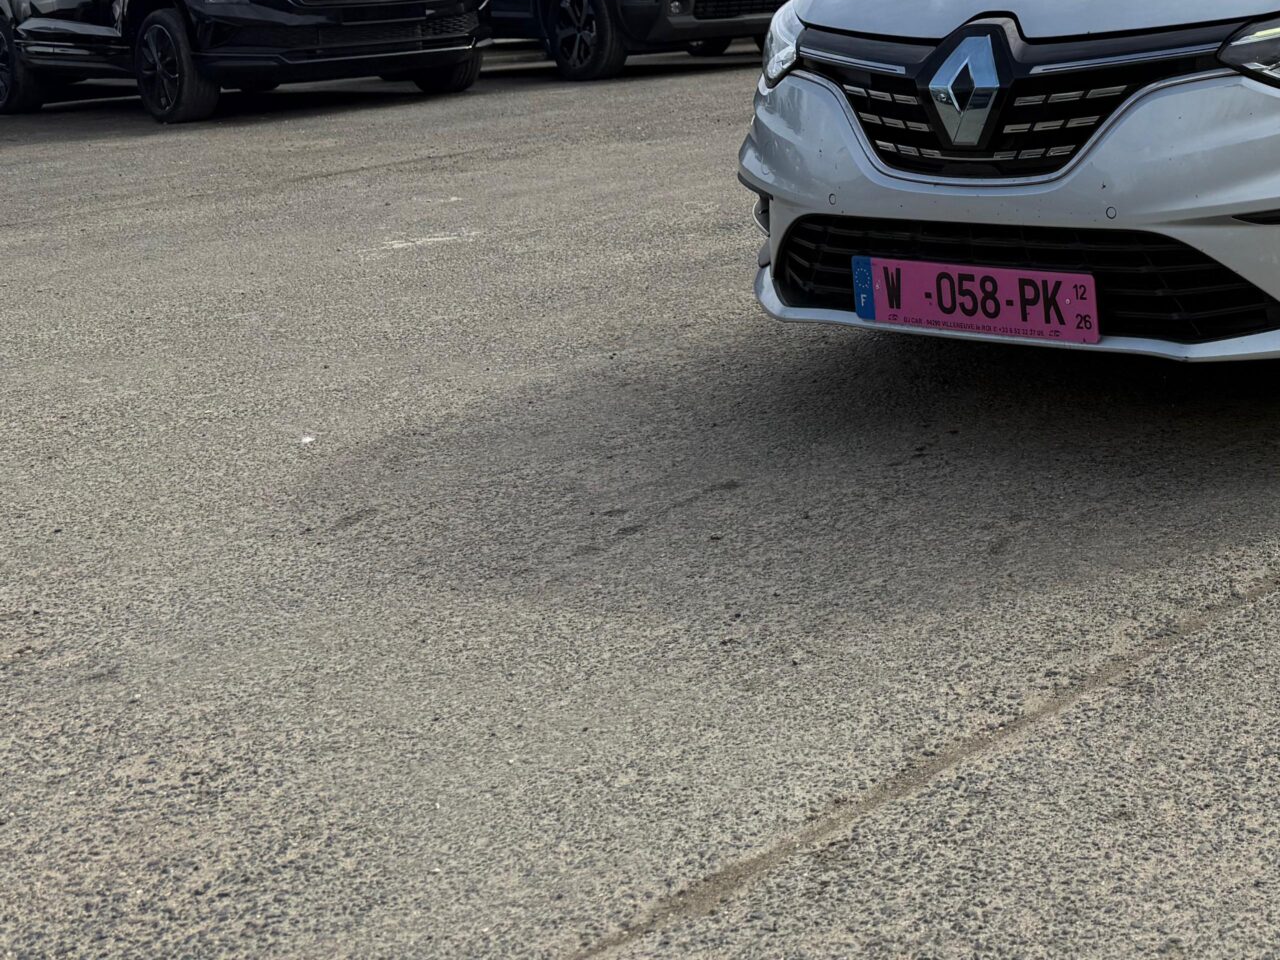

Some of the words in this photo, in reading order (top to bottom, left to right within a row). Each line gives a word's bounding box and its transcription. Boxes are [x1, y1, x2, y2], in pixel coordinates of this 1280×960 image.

[883, 266, 902, 310] W
[1072, 284, 1087, 300] 12
[860, 293, 868, 307] F
[1075, 313, 1092, 330] 26
